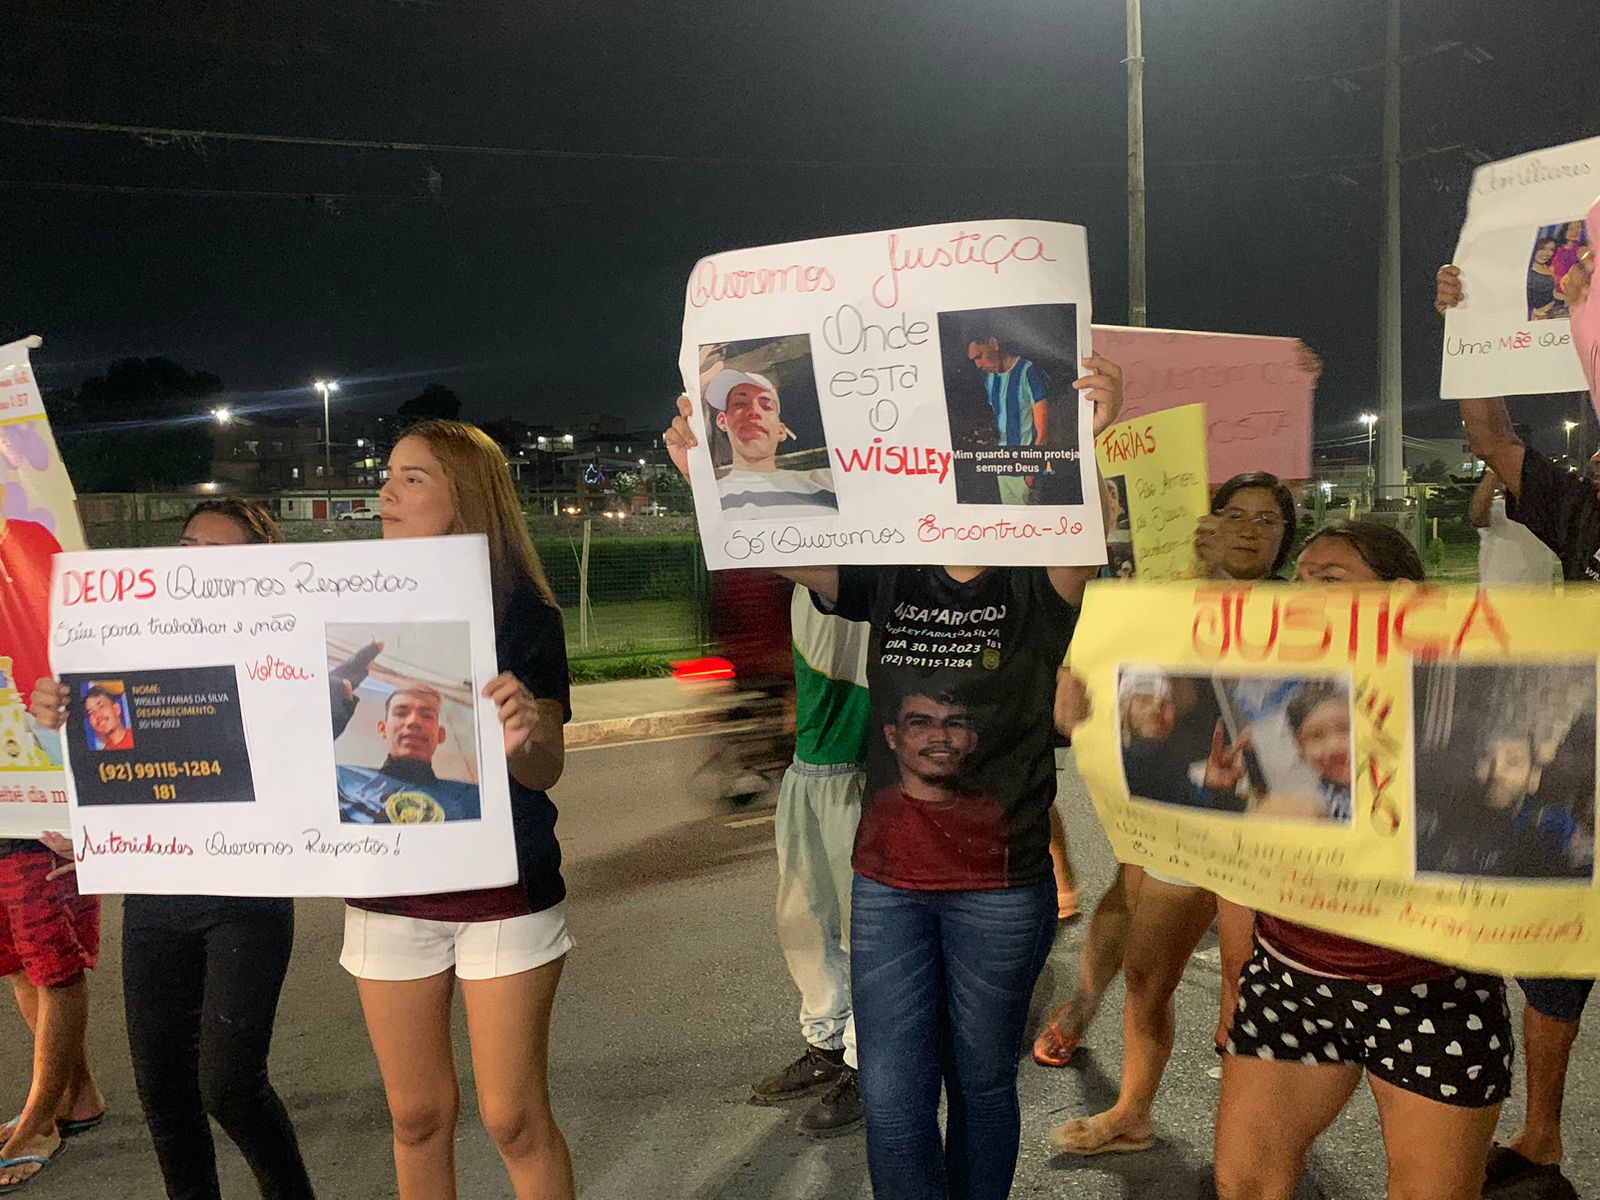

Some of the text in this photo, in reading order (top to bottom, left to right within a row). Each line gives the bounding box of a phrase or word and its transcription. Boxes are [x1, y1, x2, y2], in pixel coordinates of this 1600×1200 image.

[690, 230, 1057, 309] Queremos Justiça
[822, 304, 931, 355] Onde
[1446, 336, 1492, 357] Uma
[952, 449, 1080, 461] Mim guarda e mim proteja
[1103, 425, 1157, 463] FARIAS
[976, 463, 1040, 474] sempre Deus
[724, 529, 766, 559] Só
[771, 526, 906, 553] Queremos
[62, 560, 420, 606] DEOPS Queremos Respostas
[101, 621, 143, 648] para
[147, 616, 227, 636] trabalhar
[249, 613, 297, 637] não
[885, 639, 982, 654] DIA 30.10.2023
[881, 653, 974, 668] (92) 99115-1284
[194, 693, 206, 704] DA
[207, 692, 230, 703] SILVA
[98, 759, 222, 783] (92) 99115-1284
[152, 784, 178, 800] 181
[76, 825, 194, 861] Autoridades
[205, 831, 294, 857] Queremos
